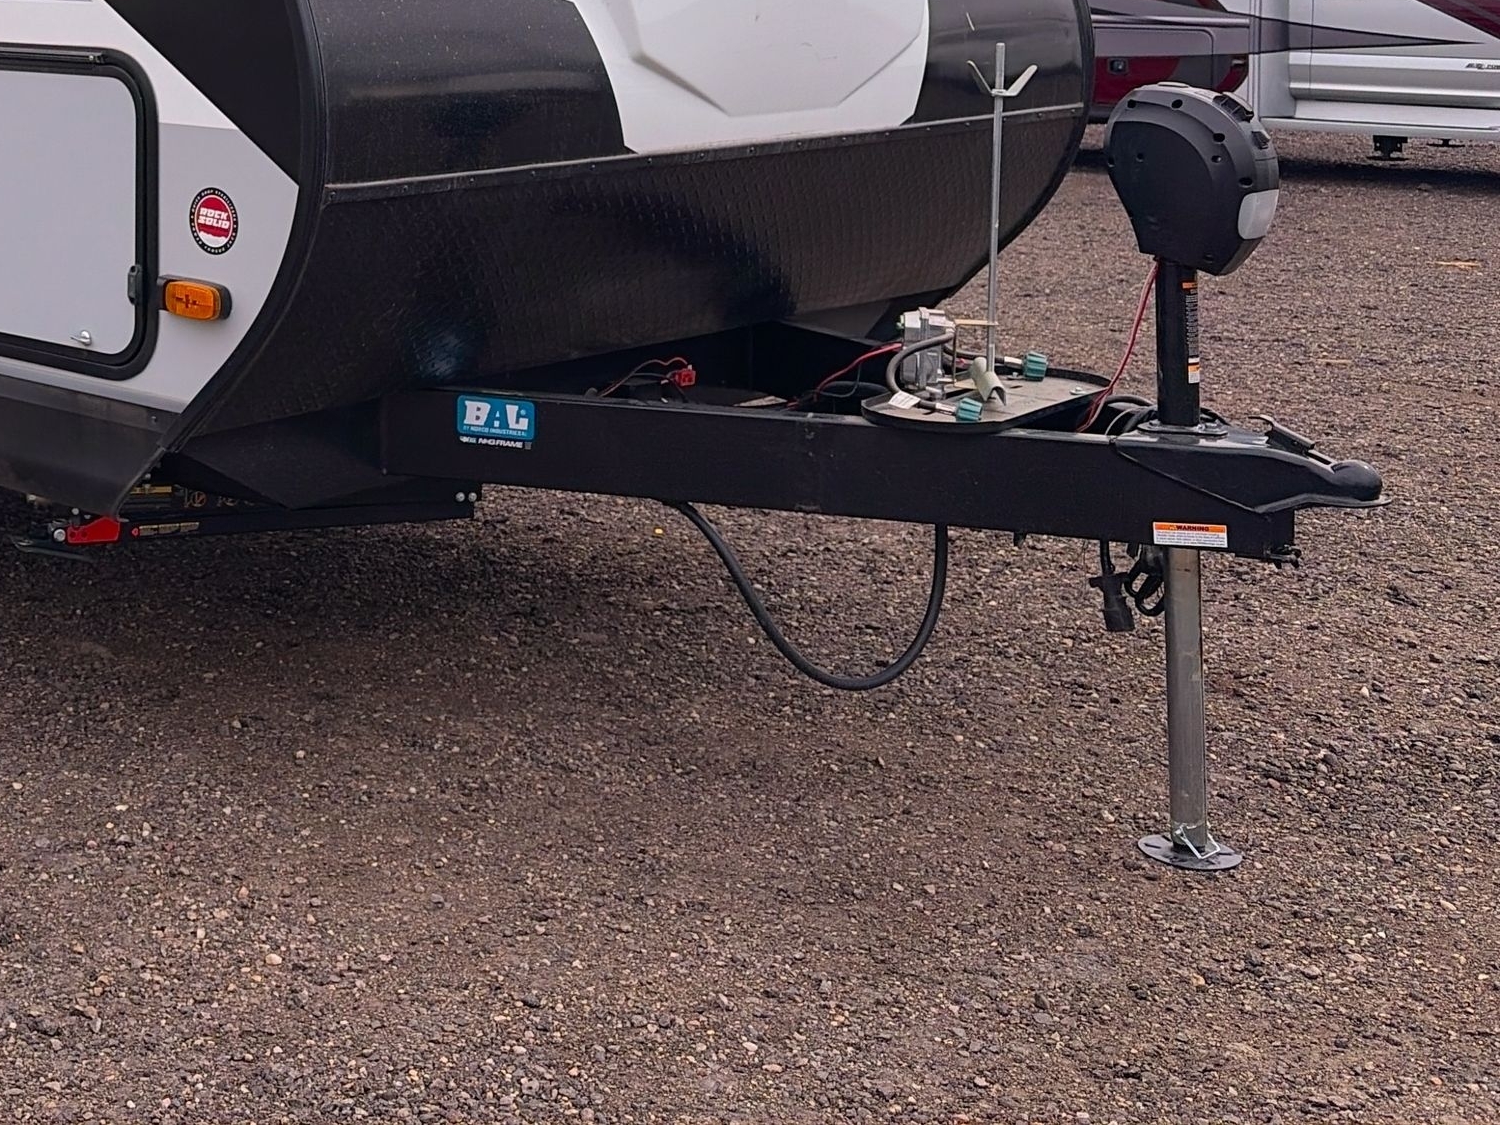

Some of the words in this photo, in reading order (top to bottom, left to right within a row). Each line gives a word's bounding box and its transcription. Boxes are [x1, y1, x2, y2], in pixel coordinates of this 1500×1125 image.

[200, 207, 228, 220] ROCK
[198, 216, 230, 229] SOLID
[496, 440, 523, 448] FRAME
[1176, 524, 1210, 532] WARNING
